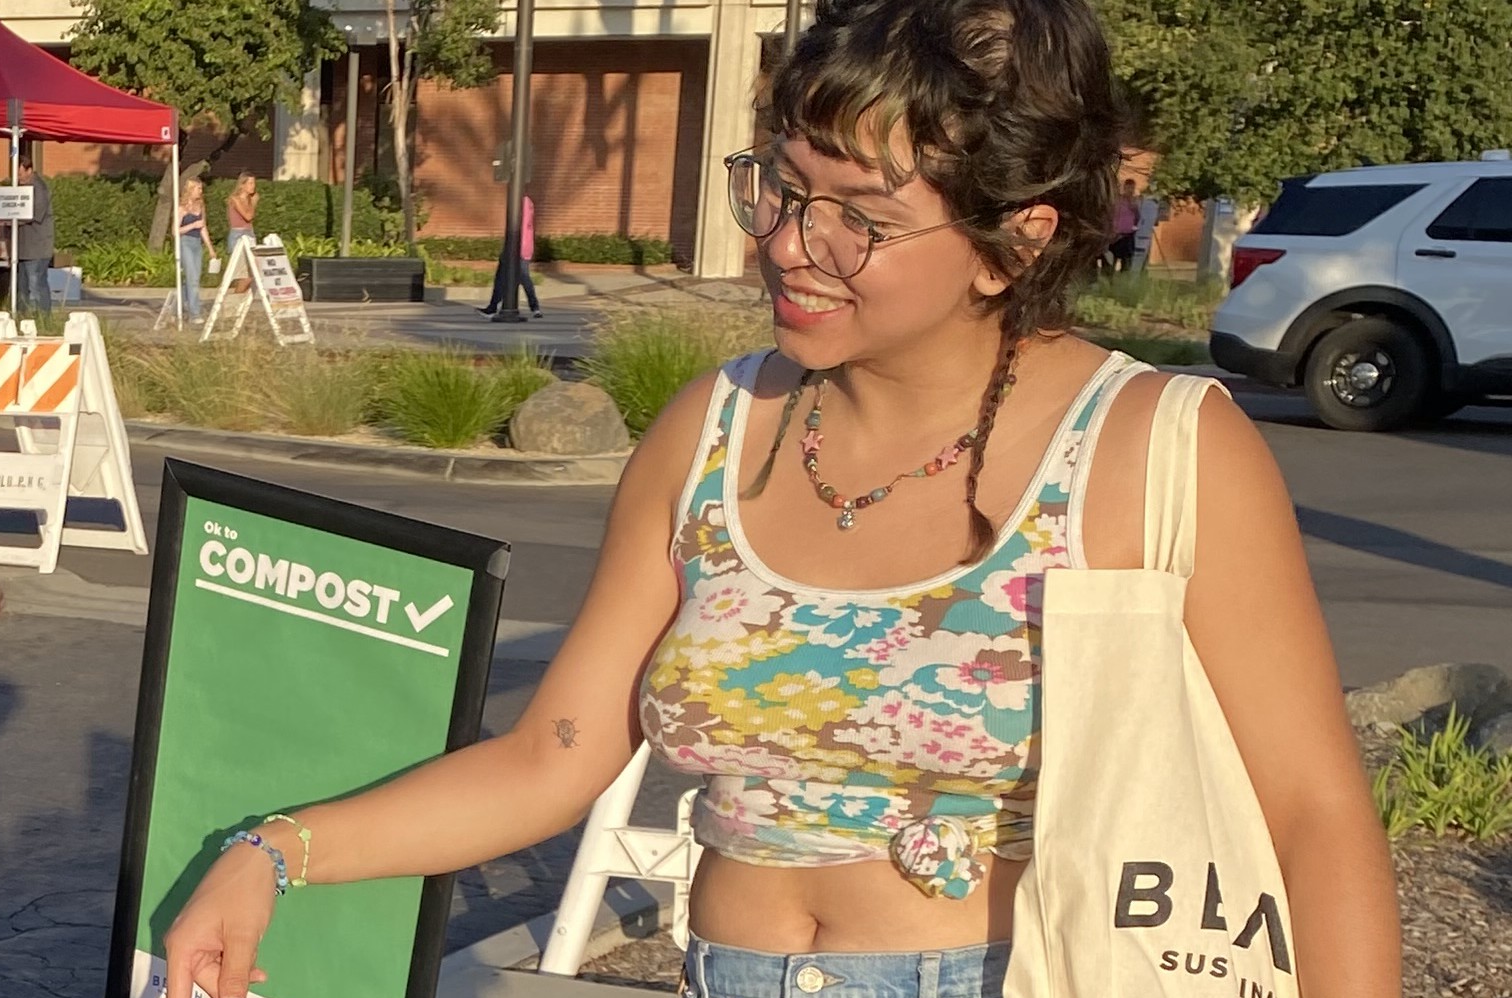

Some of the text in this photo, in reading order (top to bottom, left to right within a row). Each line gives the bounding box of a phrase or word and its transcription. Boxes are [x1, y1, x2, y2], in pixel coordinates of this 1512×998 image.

[203, 520, 238, 540] Ok to
[199, 540, 400, 624] COMPOST
